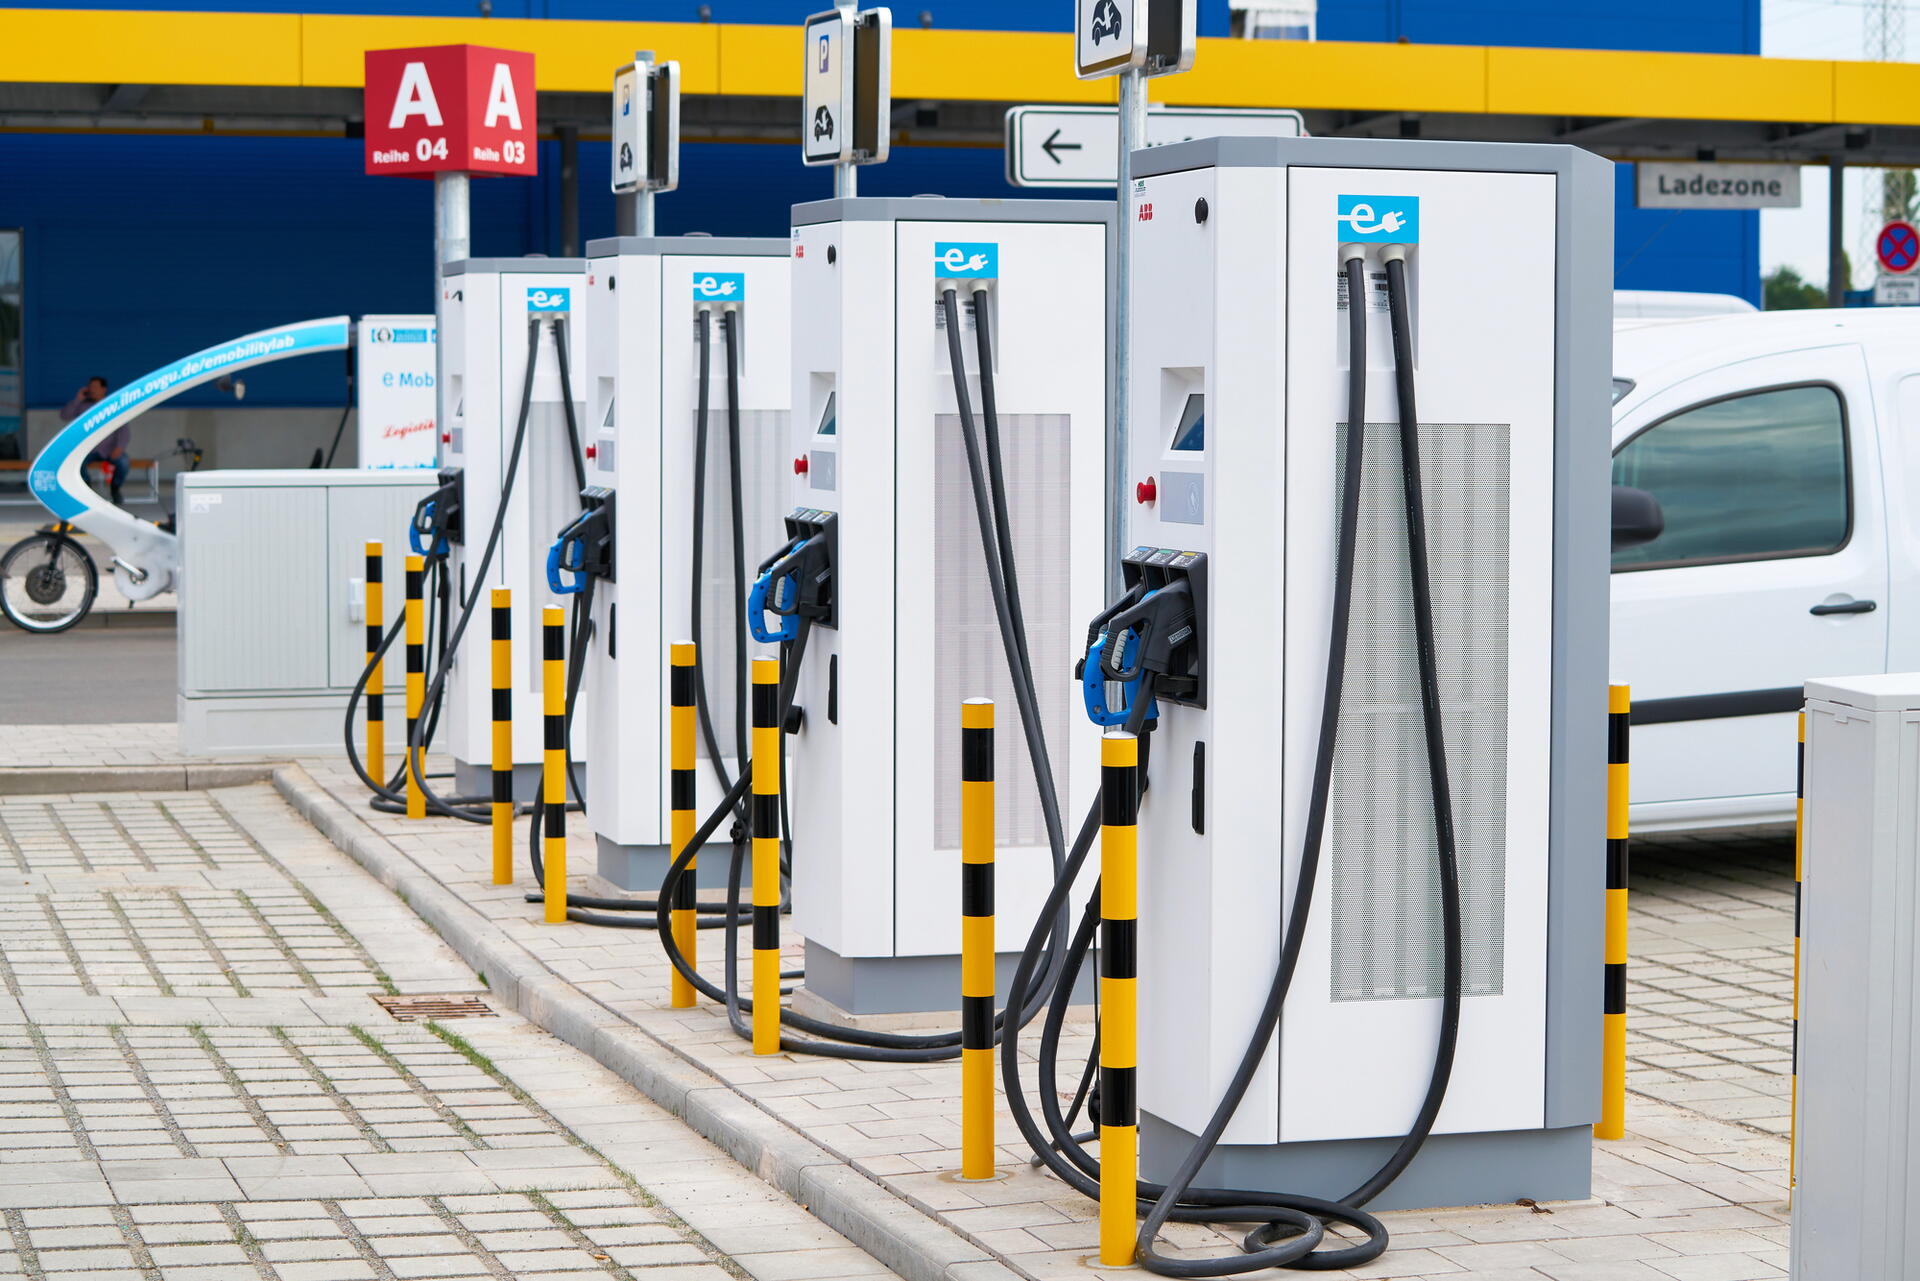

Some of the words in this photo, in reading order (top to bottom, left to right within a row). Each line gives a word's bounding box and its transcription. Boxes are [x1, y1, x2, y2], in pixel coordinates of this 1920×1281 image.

[388, 61, 444, 129] A
[484, 62, 523, 130] A
[373, 150, 410, 164] Reihe
[416, 138, 449, 161] 04
[472, 147, 500, 162] Reihe
[503, 141, 526, 165] 03
[1658, 174, 1782, 197] Ladezone
[1138, 203, 1153, 222] ABB
[83, 335, 295, 432] www.ilm.ovgu.de/emobilitylab
[383, 371, 394, 387] e
